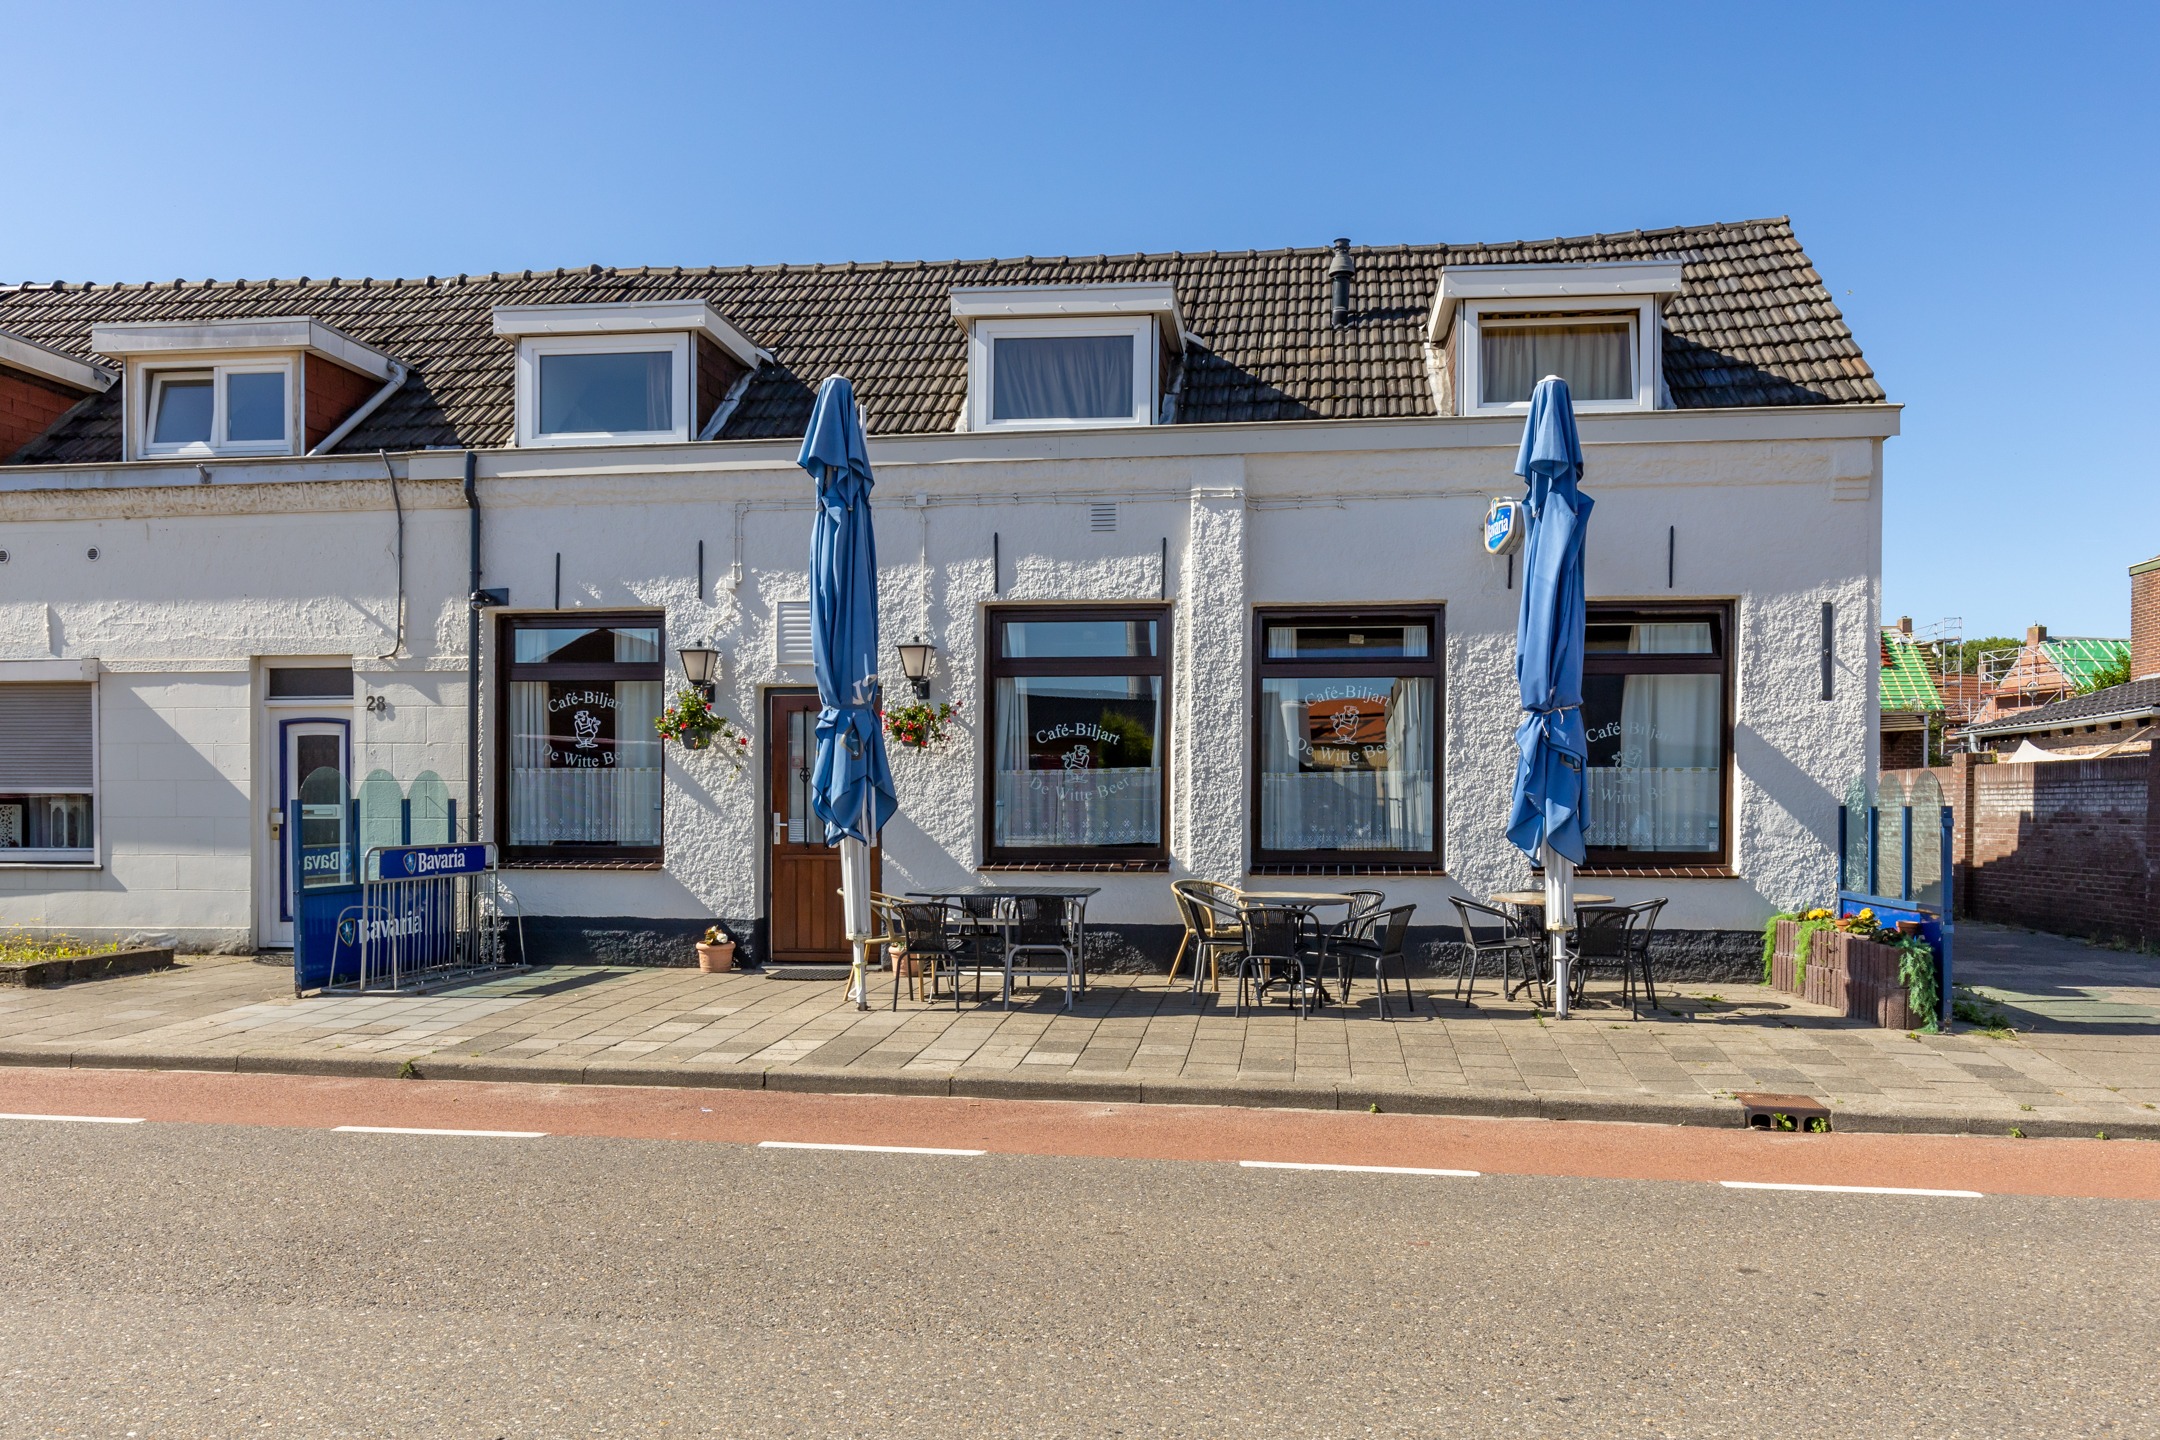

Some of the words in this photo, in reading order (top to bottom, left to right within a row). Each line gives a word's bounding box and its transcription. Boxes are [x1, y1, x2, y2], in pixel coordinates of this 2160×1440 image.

[366, 695, 386, 712] 28
[1304, 685, 1391, 707] Café-Biljart
[1036, 722, 1121, 745] Café-Biljart
[542, 743, 559, 761] De
[564, 751, 600, 768] Witte
[1298, 737, 1314, 756] De
[1320, 746, 1360, 762] Witte
[1030, 776, 1049, 795] De
[1056, 785, 1093, 801] Witte
[1096, 776, 1130, 798] Beer
[418, 848, 465, 873] Bavaria
[357, 910, 423, 944] Bavaria
